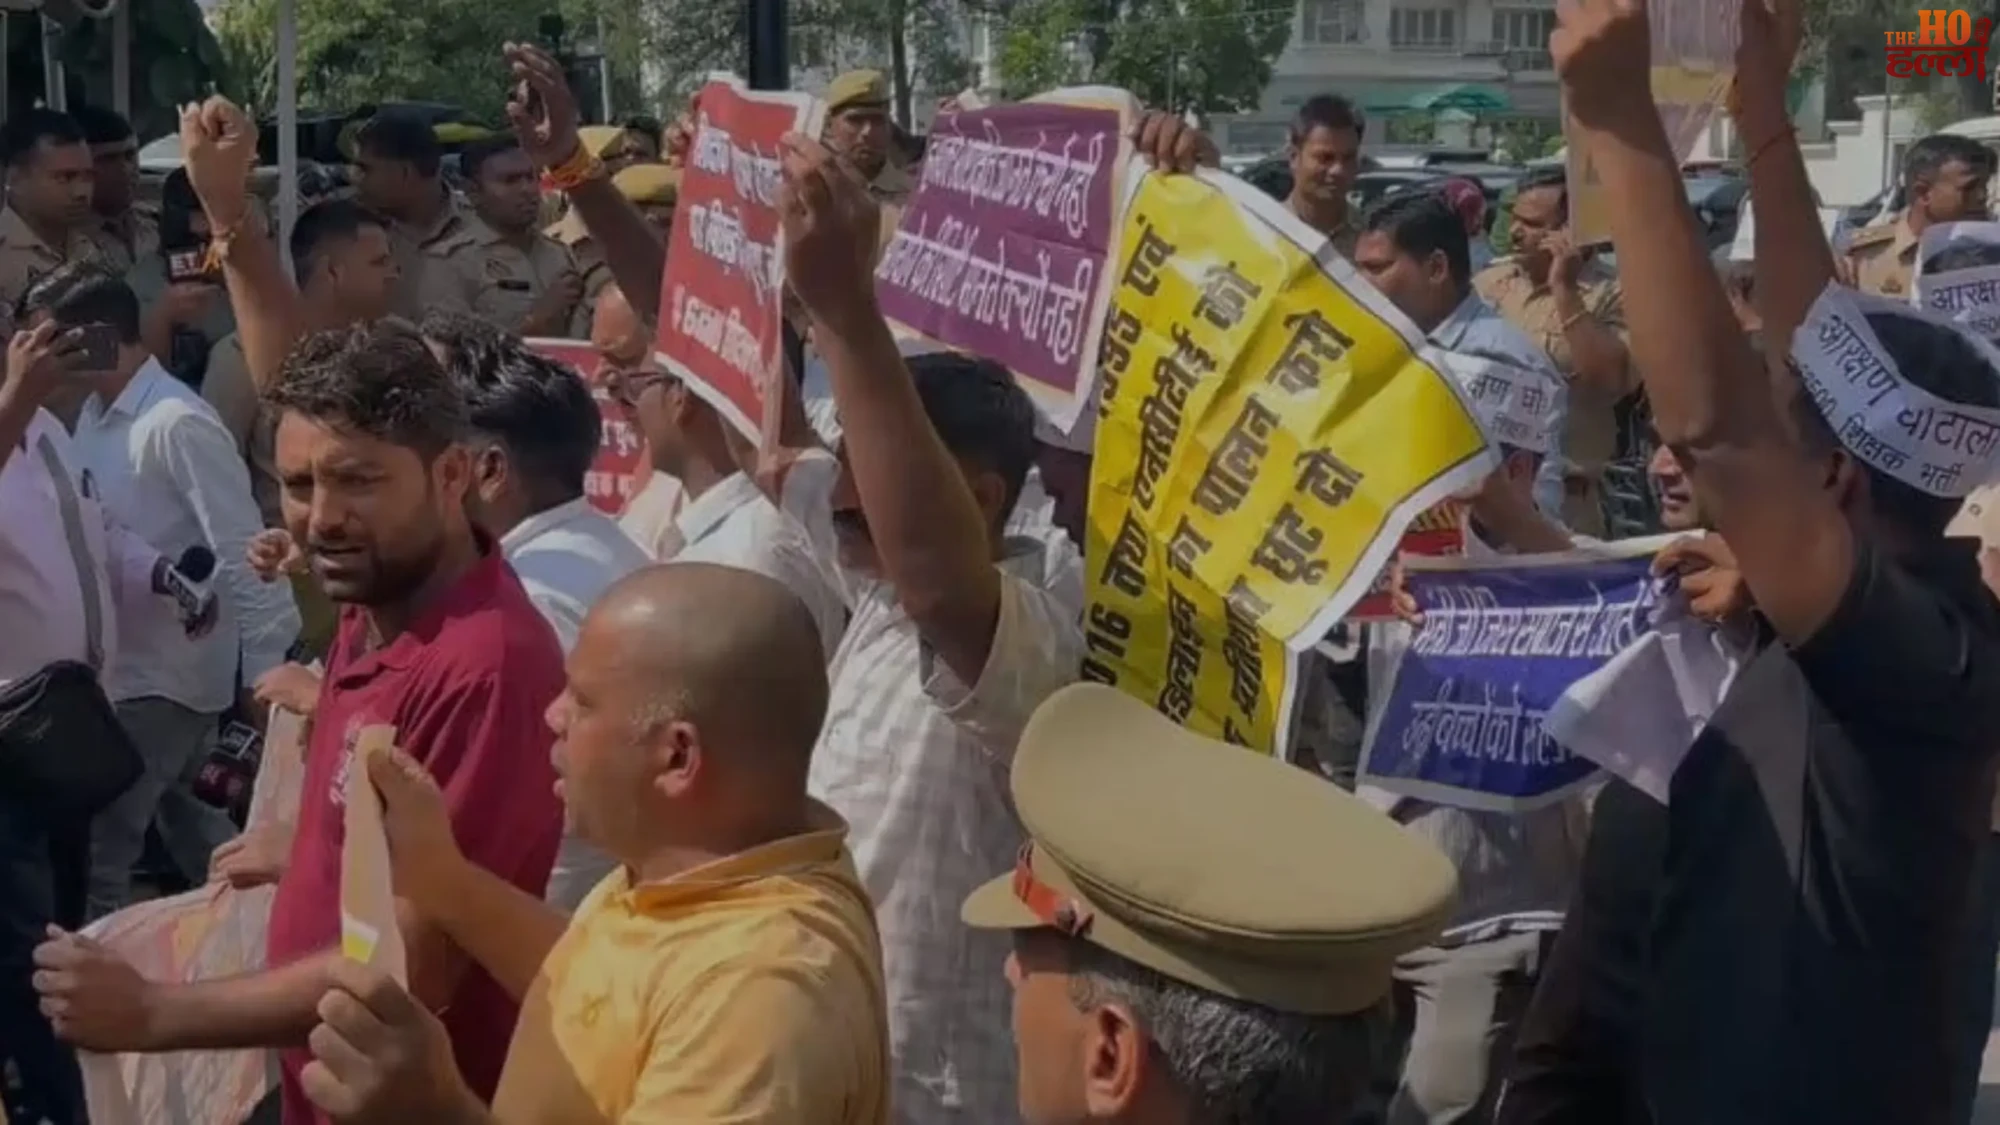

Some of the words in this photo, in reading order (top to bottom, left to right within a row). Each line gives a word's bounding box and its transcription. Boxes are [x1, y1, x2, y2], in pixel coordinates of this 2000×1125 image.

[1121, 213, 1178, 297] एवं
[1929, 278, 2000, 312] आरक्ष
[1818, 313, 1900, 407] आरक्षण
[1167, 514, 1213, 581] का
[1191, 393, 1281, 517] पालन
[1264, 309, 1356, 395] करो
[1838, 412, 1912, 471] शिक्षक
[1919, 462, 1966, 492] भर्ती
[1248, 502, 1329, 586] छूट
[1293, 447, 1365, 508] दो
